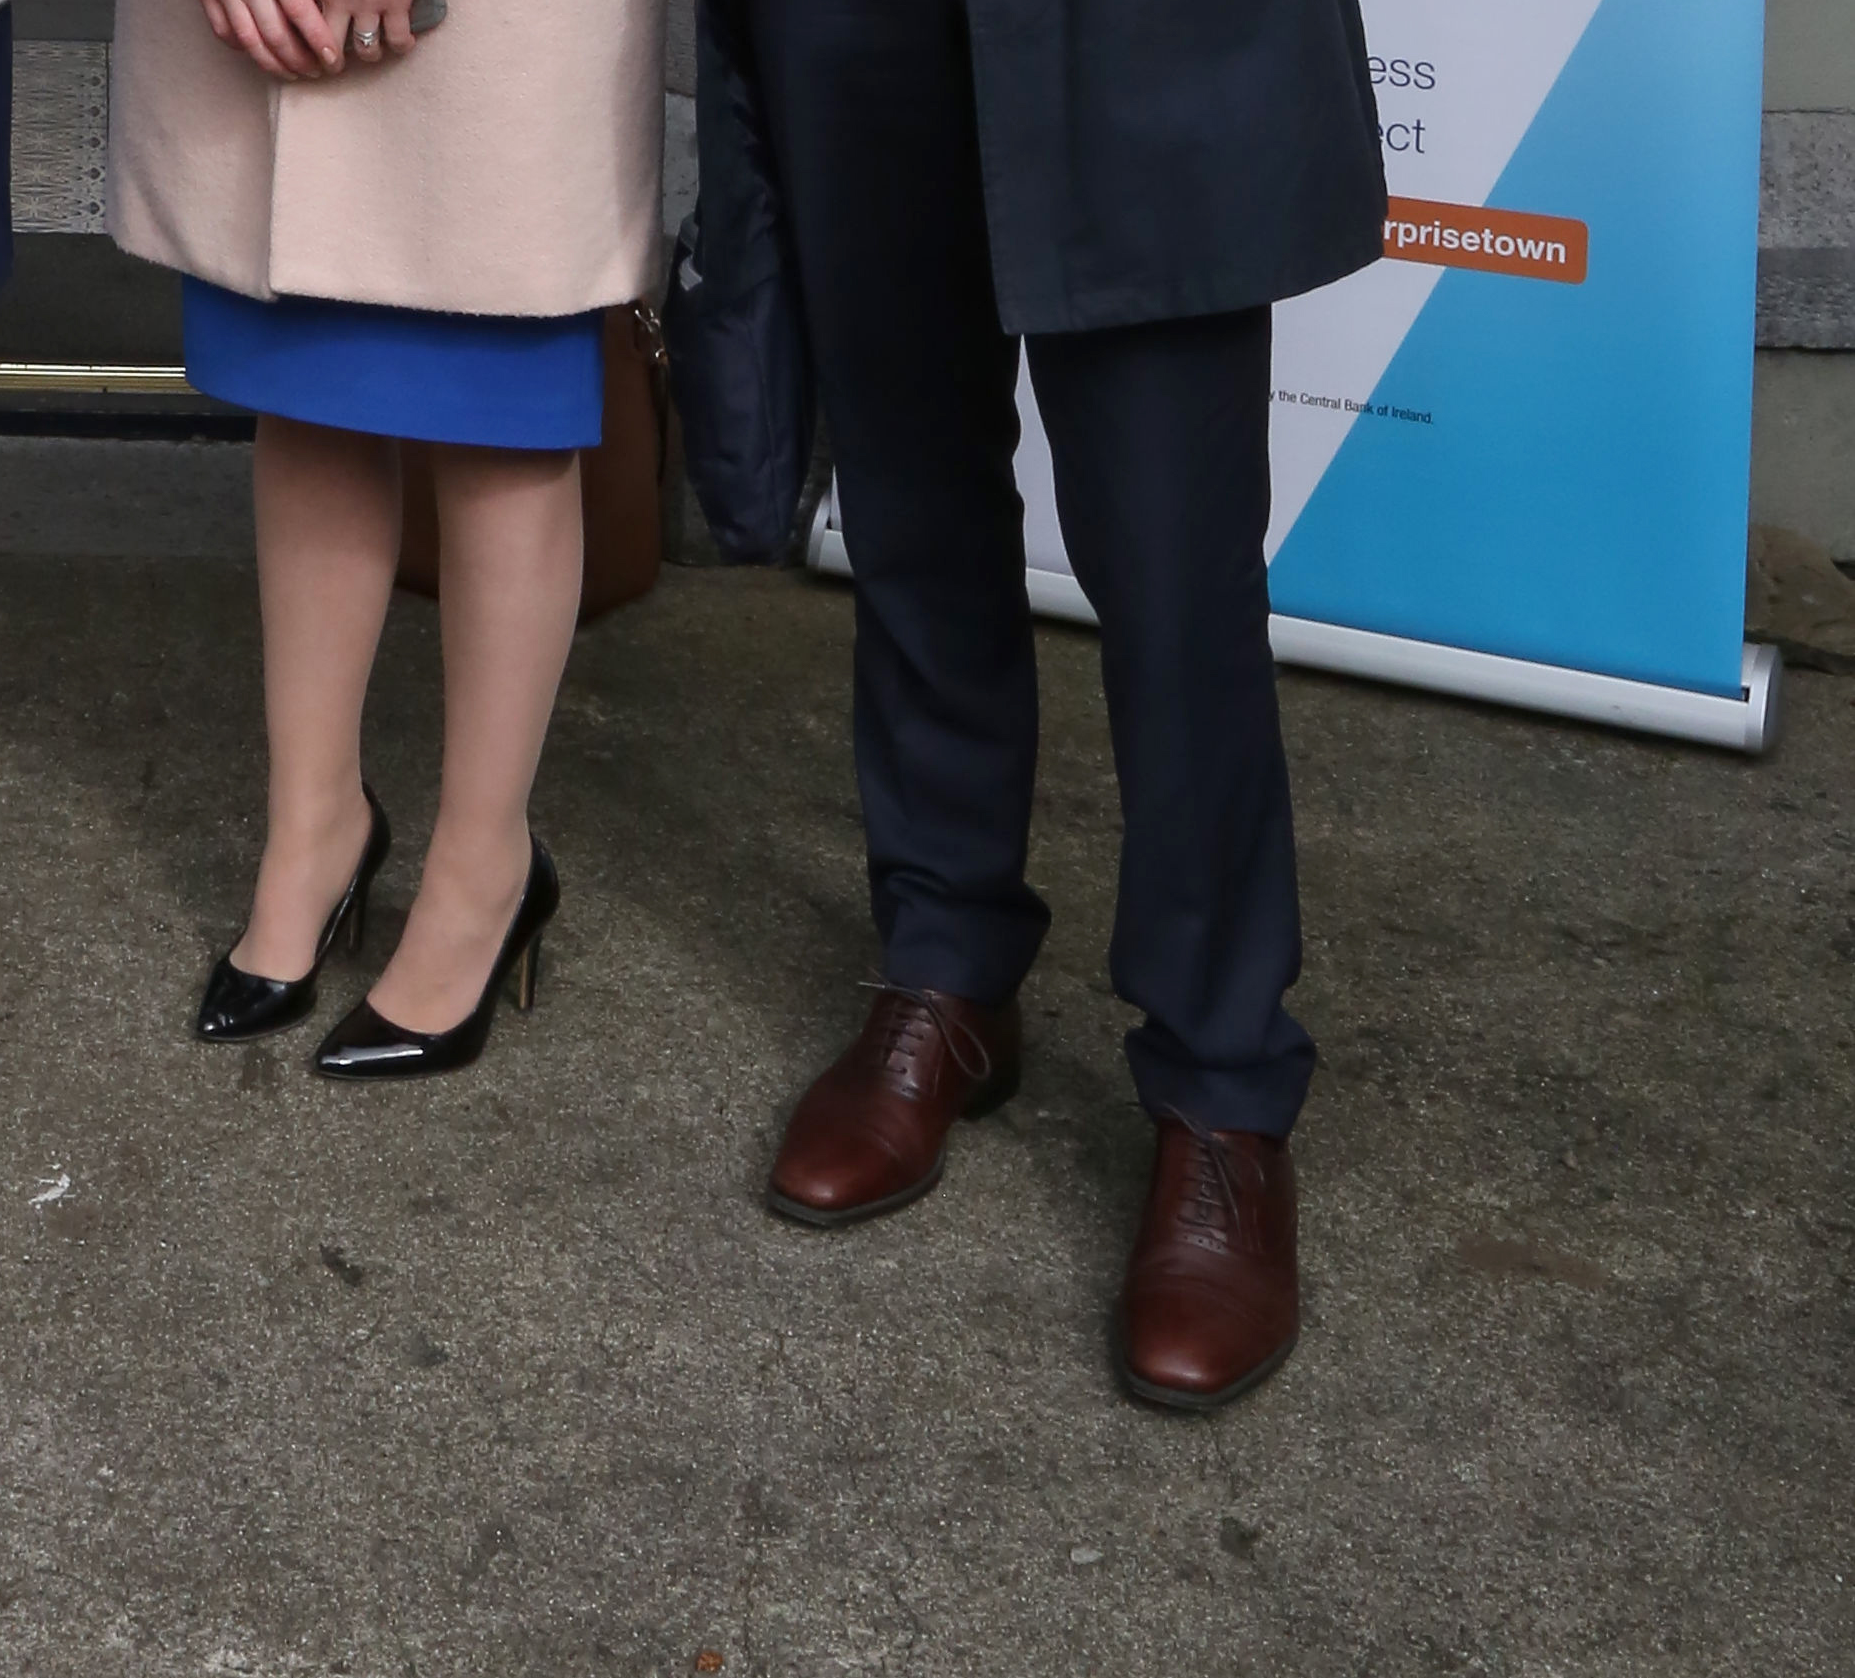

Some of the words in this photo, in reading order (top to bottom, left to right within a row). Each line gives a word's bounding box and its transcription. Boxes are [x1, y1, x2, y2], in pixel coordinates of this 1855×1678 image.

[1278, 389, 1297, 404] the
[1300, 392, 1341, 410] Central
[1345, 398, 1375, 415] Bank
[1377, 404, 1388, 417] of
